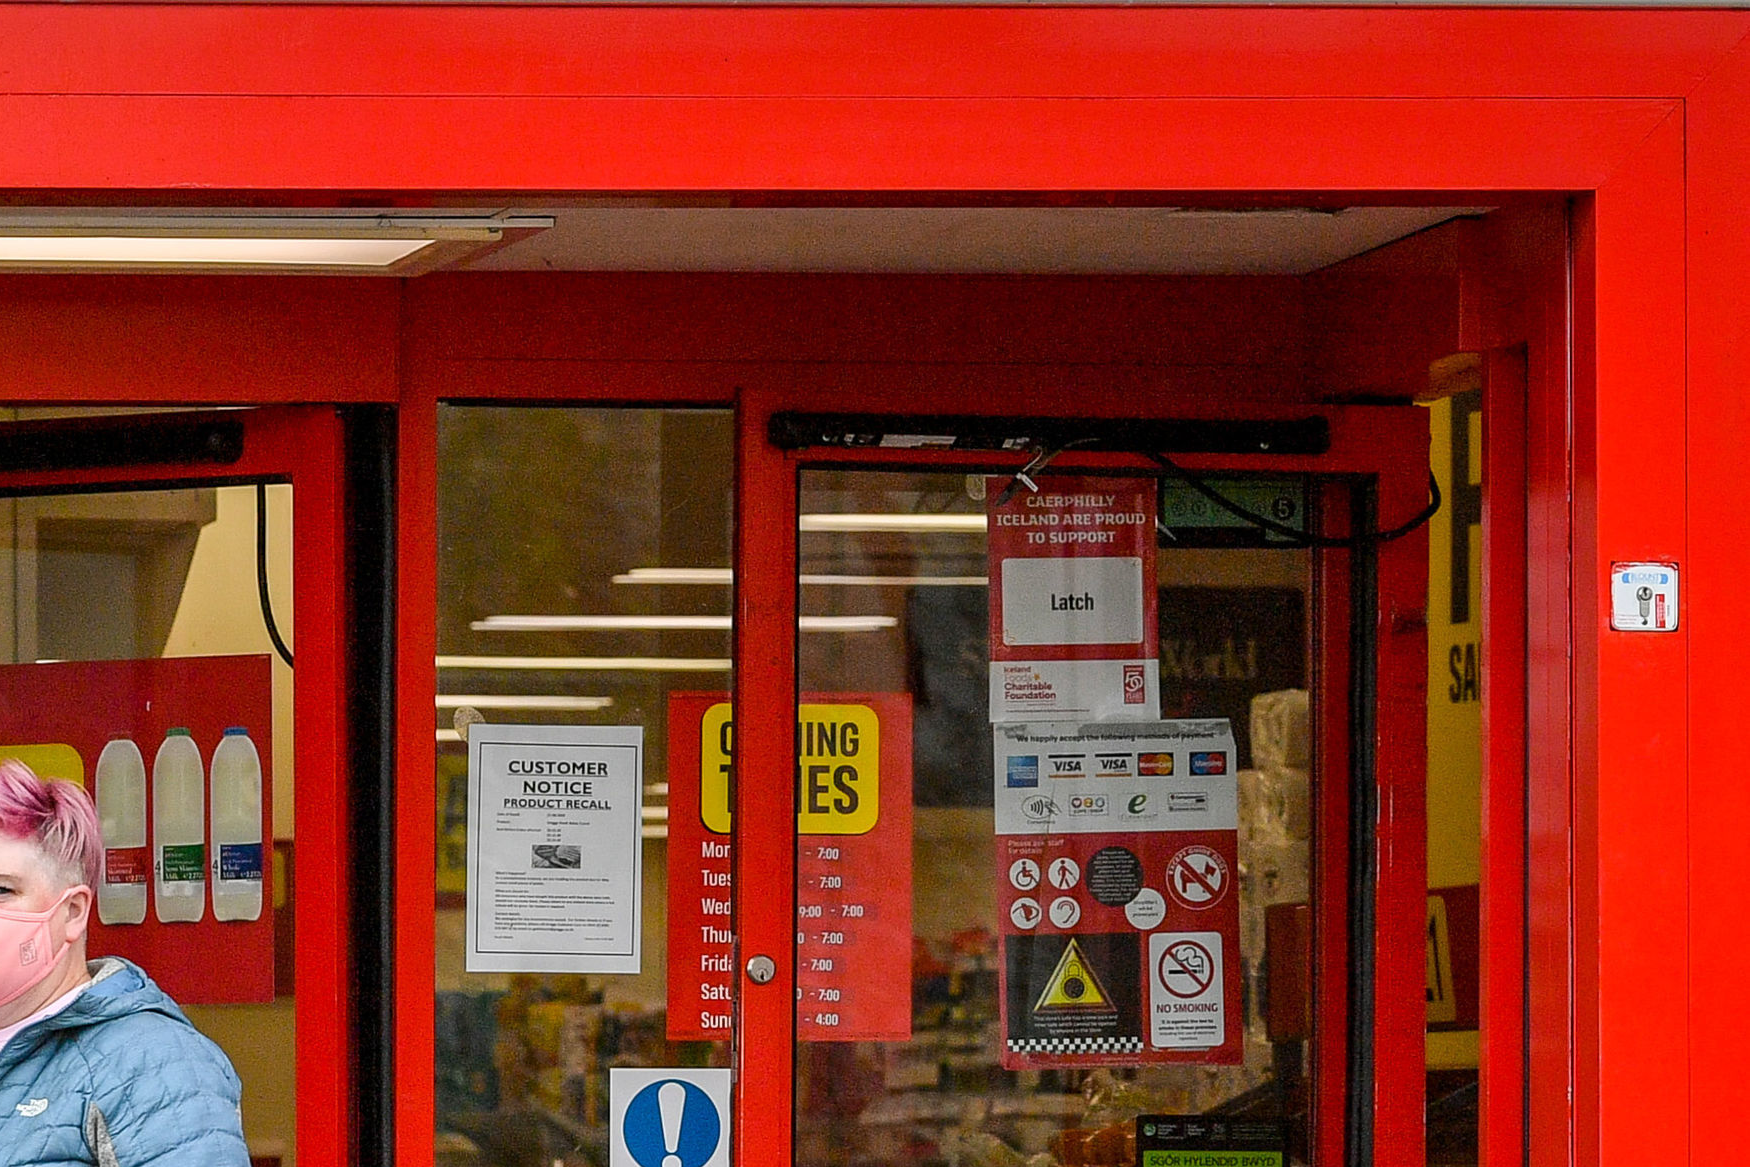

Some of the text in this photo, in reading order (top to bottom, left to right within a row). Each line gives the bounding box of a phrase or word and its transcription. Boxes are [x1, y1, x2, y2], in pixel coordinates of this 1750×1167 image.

[1026, 494, 1116, 508] CAERPHILLY
[1278, 500, 1289, 518] 5
[996, 513, 1146, 527] ICELAND ARE PROUD
[1026, 531, 1116, 544] TO SUPPORT
[1050, 592, 1095, 612] Latch
[1003, 665, 1032, 673] Iceland
[1450, 643, 1481, 704] SA
[1004, 682, 1053, 691] Charitable
[1004, 691, 1057, 700] Foundation
[508, 760, 608, 775] CUSTOMER
[1053, 760, 1082, 771] VISA
[1100, 759, 1128, 770] VISA
[523, 781, 593, 795] NOTICE
[503, 798, 612, 811] PRODUCT RECALL
[817, 847, 839, 860] 7:00
[819, 876, 841, 889] 7:00
[799, 905, 822, 918] 9:00
[842, 905, 864, 918] 7:00
[821, 932, 843, 944] 7:00
[811, 959, 832, 971] 7:00
[818, 989, 840, 1001] 7:00
[1156, 1002, 1219, 1014] NO SMOKING
[815, 1013, 839, 1026] 4:00
[1183, 1155, 1239, 1167] HYLENDID
[1241, 1156, 1276, 1167] BWYD
